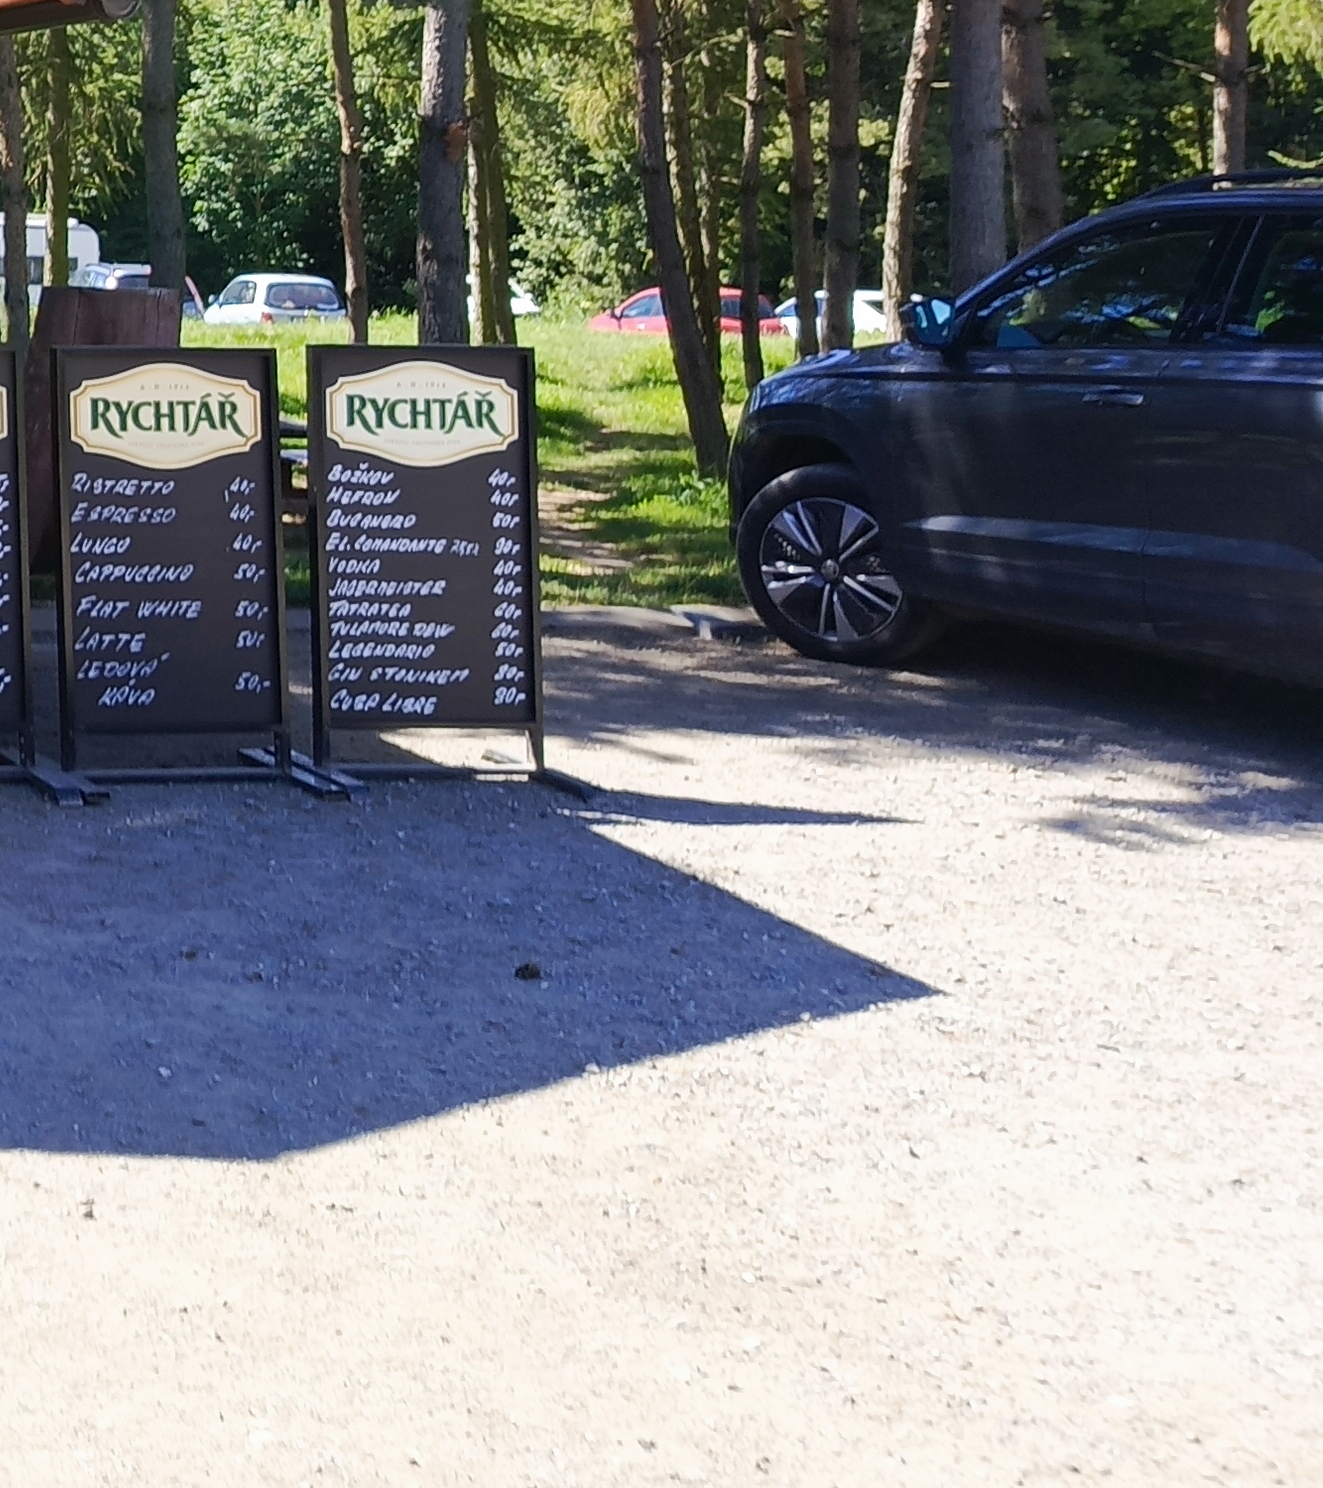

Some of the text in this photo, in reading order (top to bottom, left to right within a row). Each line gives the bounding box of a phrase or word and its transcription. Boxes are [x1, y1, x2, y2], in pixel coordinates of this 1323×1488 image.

[90, 392, 250, 439] RYCHTÁŘ
[345, 390, 505, 437] RYCHTÁŘ
[71, 472, 175, 496] RISTRETTO
[327, 461, 395, 486] BOŽKOV
[70, 502, 176, 524] ESPRESSO
[70, 532, 131, 555] LUNGO
[75, 561, 194, 583] CAPPUCCINO
[328, 556, 381, 574] VODKA
[76, 595, 130, 619] FLAT
[137, 600, 202, 619] WHITE
[74, 626, 146, 653] LATTE
